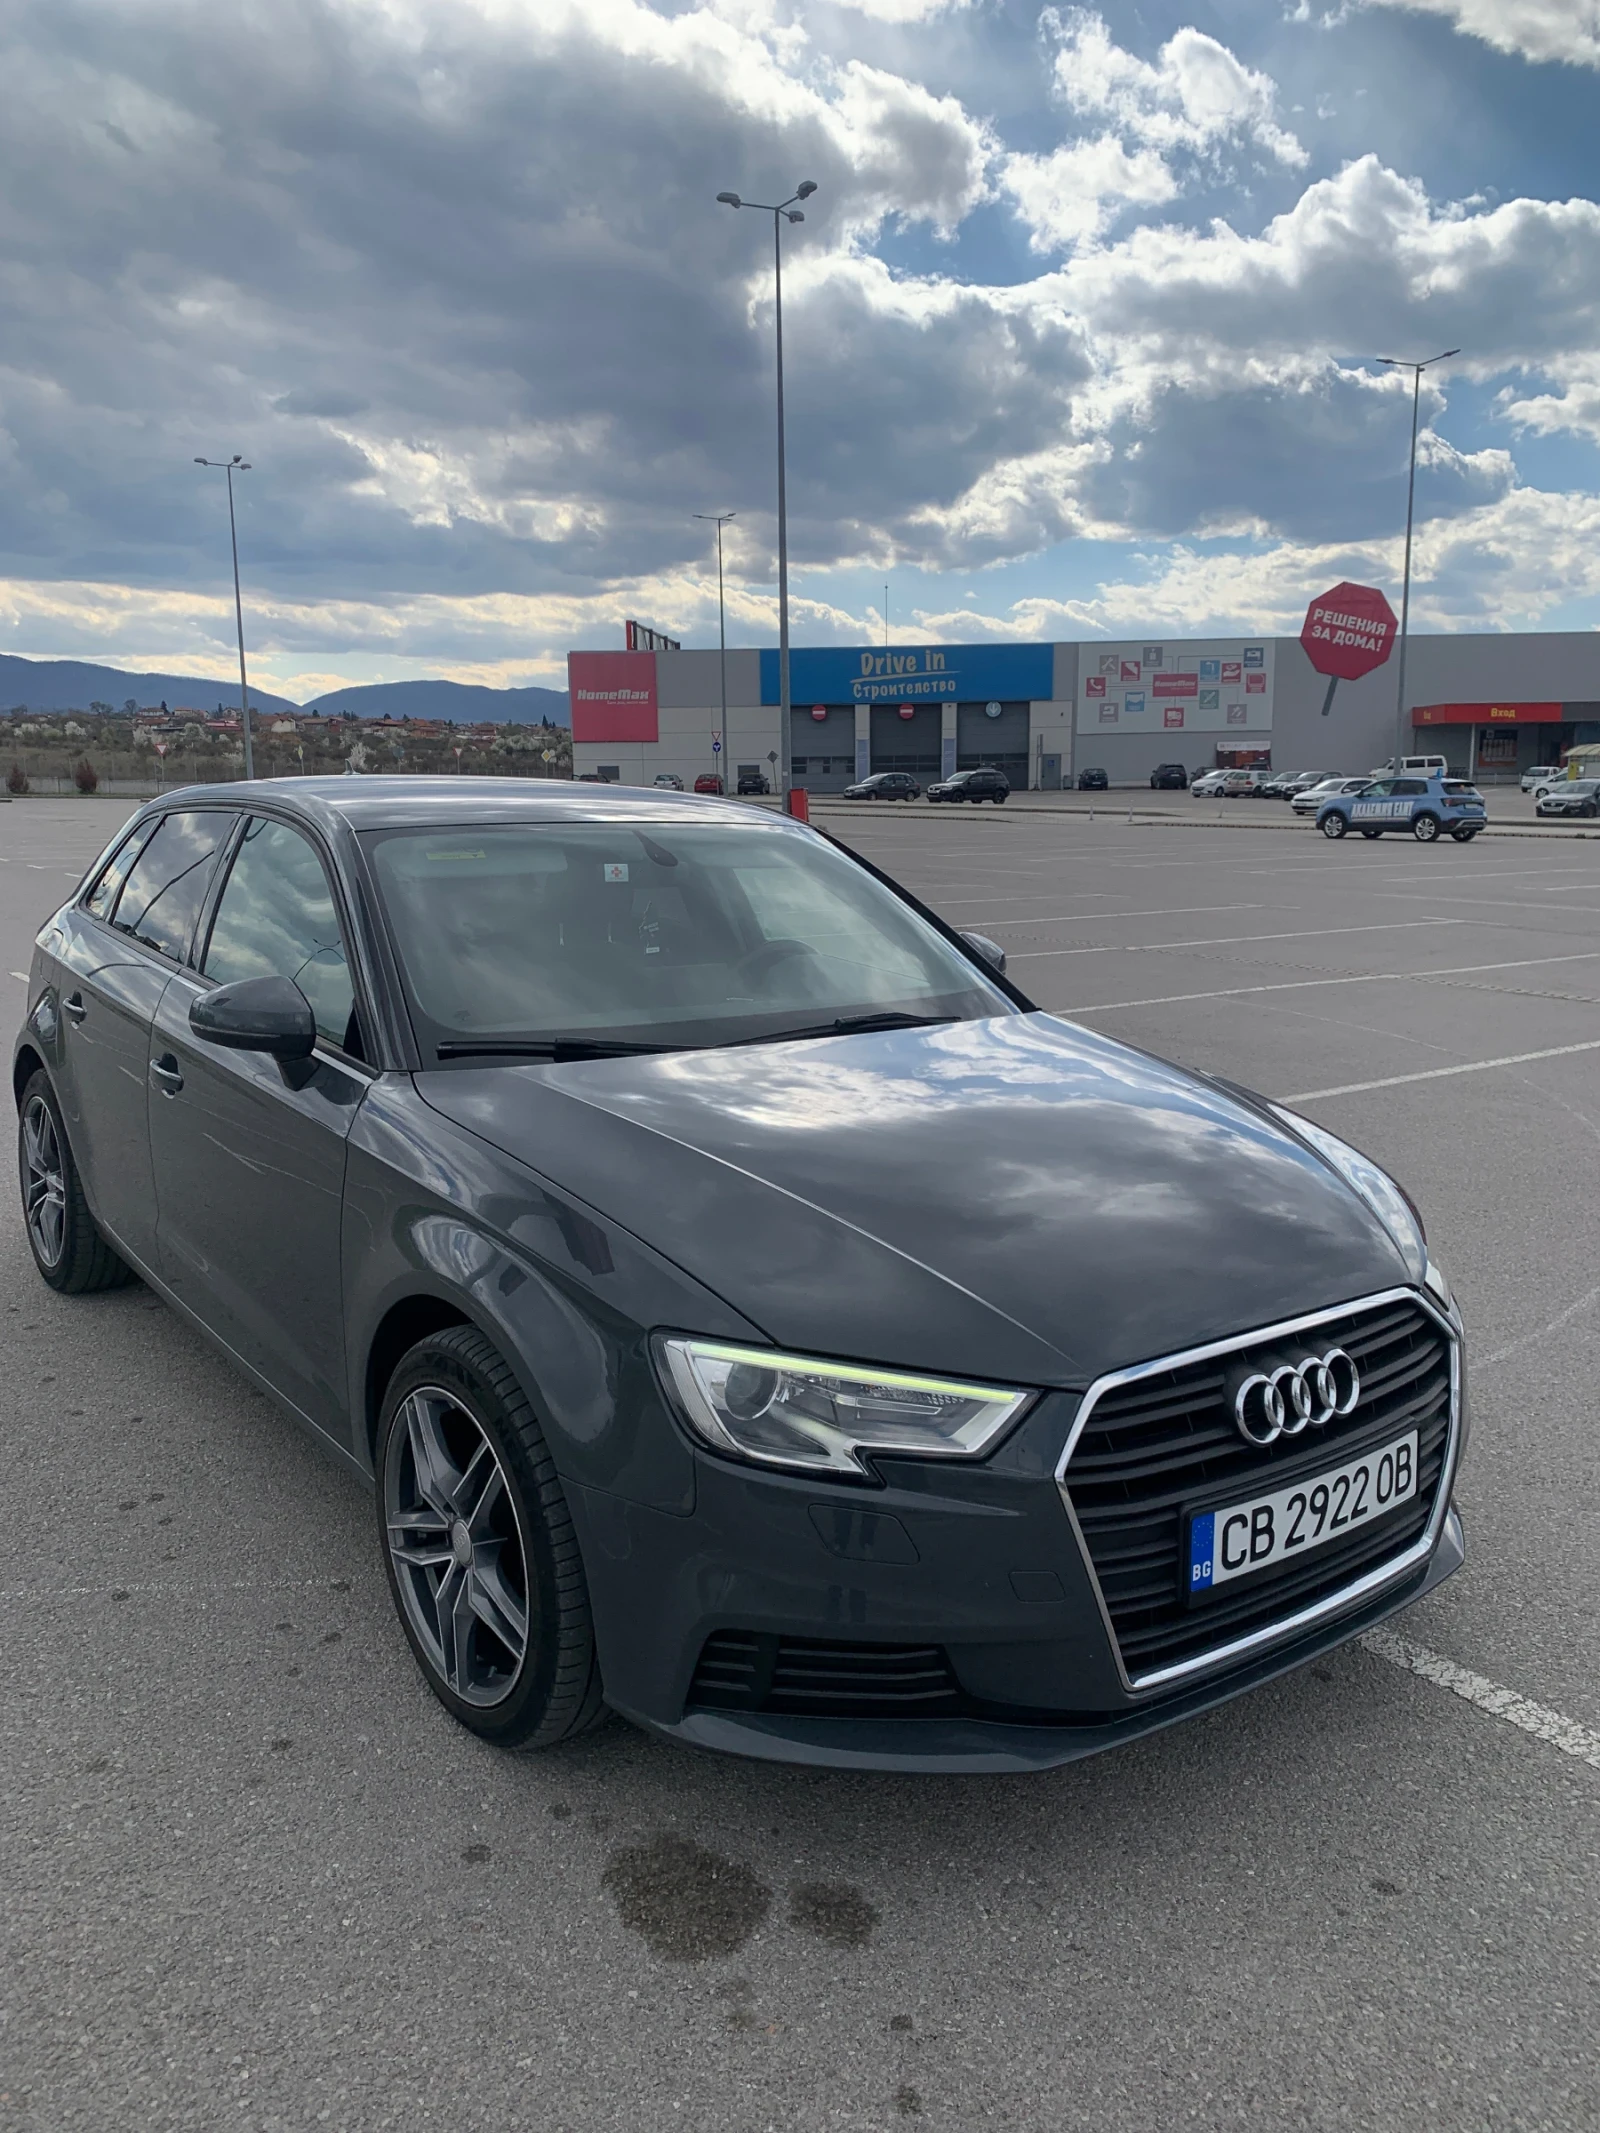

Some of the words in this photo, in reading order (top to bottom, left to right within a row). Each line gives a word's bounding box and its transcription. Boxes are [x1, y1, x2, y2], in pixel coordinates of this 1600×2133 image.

[1313, 608, 1387, 636] РЕШЕНИЯ
[1312, 625, 1331, 641] ЗА
[1332, 629, 1383, 652] ДОМА!
[861, 652, 917, 676] Drive
[925, 649, 945, 671] in
[577, 689, 649, 700] HomeMax
[853, 680, 956, 700] Строителство
[1491, 707, 1516, 718] Вход
[1221, 1505, 1275, 1571] CB
[1284, 1465, 1370, 1550] 2922
[1192, 1560, 1212, 1582] BG
